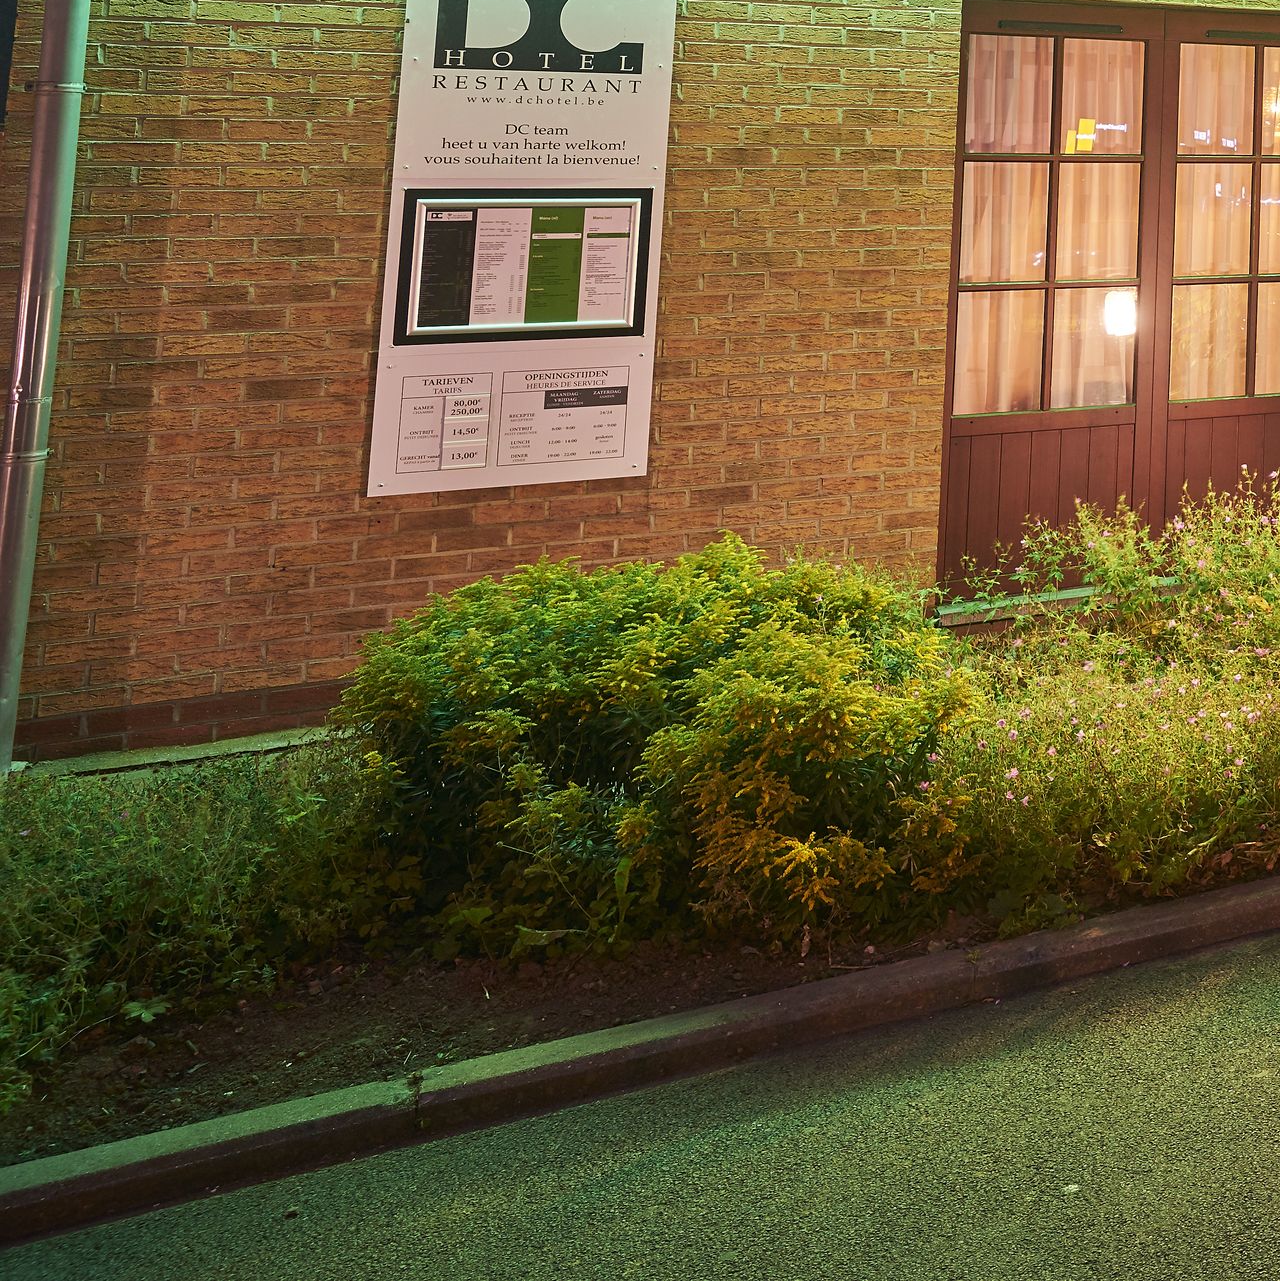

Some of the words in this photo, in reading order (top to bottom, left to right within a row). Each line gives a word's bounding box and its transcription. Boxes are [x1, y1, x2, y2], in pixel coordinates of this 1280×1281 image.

[443, 49, 635, 72] HOTEL
[431, 74, 643, 94] RESTAURANT
[466, 95, 605, 106] www.dchotel.be
[504, 124, 530, 135] DC
[534, 125, 569, 136] team
[441, 138, 474, 150] heet
[478, 140, 488, 150] u
[492, 141, 519, 150] van
[523, 138, 561, 151] harte
[564, 139, 627, 151] welkom!
[424, 155, 460, 164] vous
[464, 153, 542, 165] souhaitent
[546, 154, 559, 165] la
[562, 154, 641, 166] bienvenue!
[525, 370, 608, 381] OPENINGSTIJDEN
[422, 376, 474, 387] TARIEVEN
[526, 381, 559, 390] HEURES
[573, 379, 606, 387] SERVICE
[433, 387, 462, 395] TARIFS
